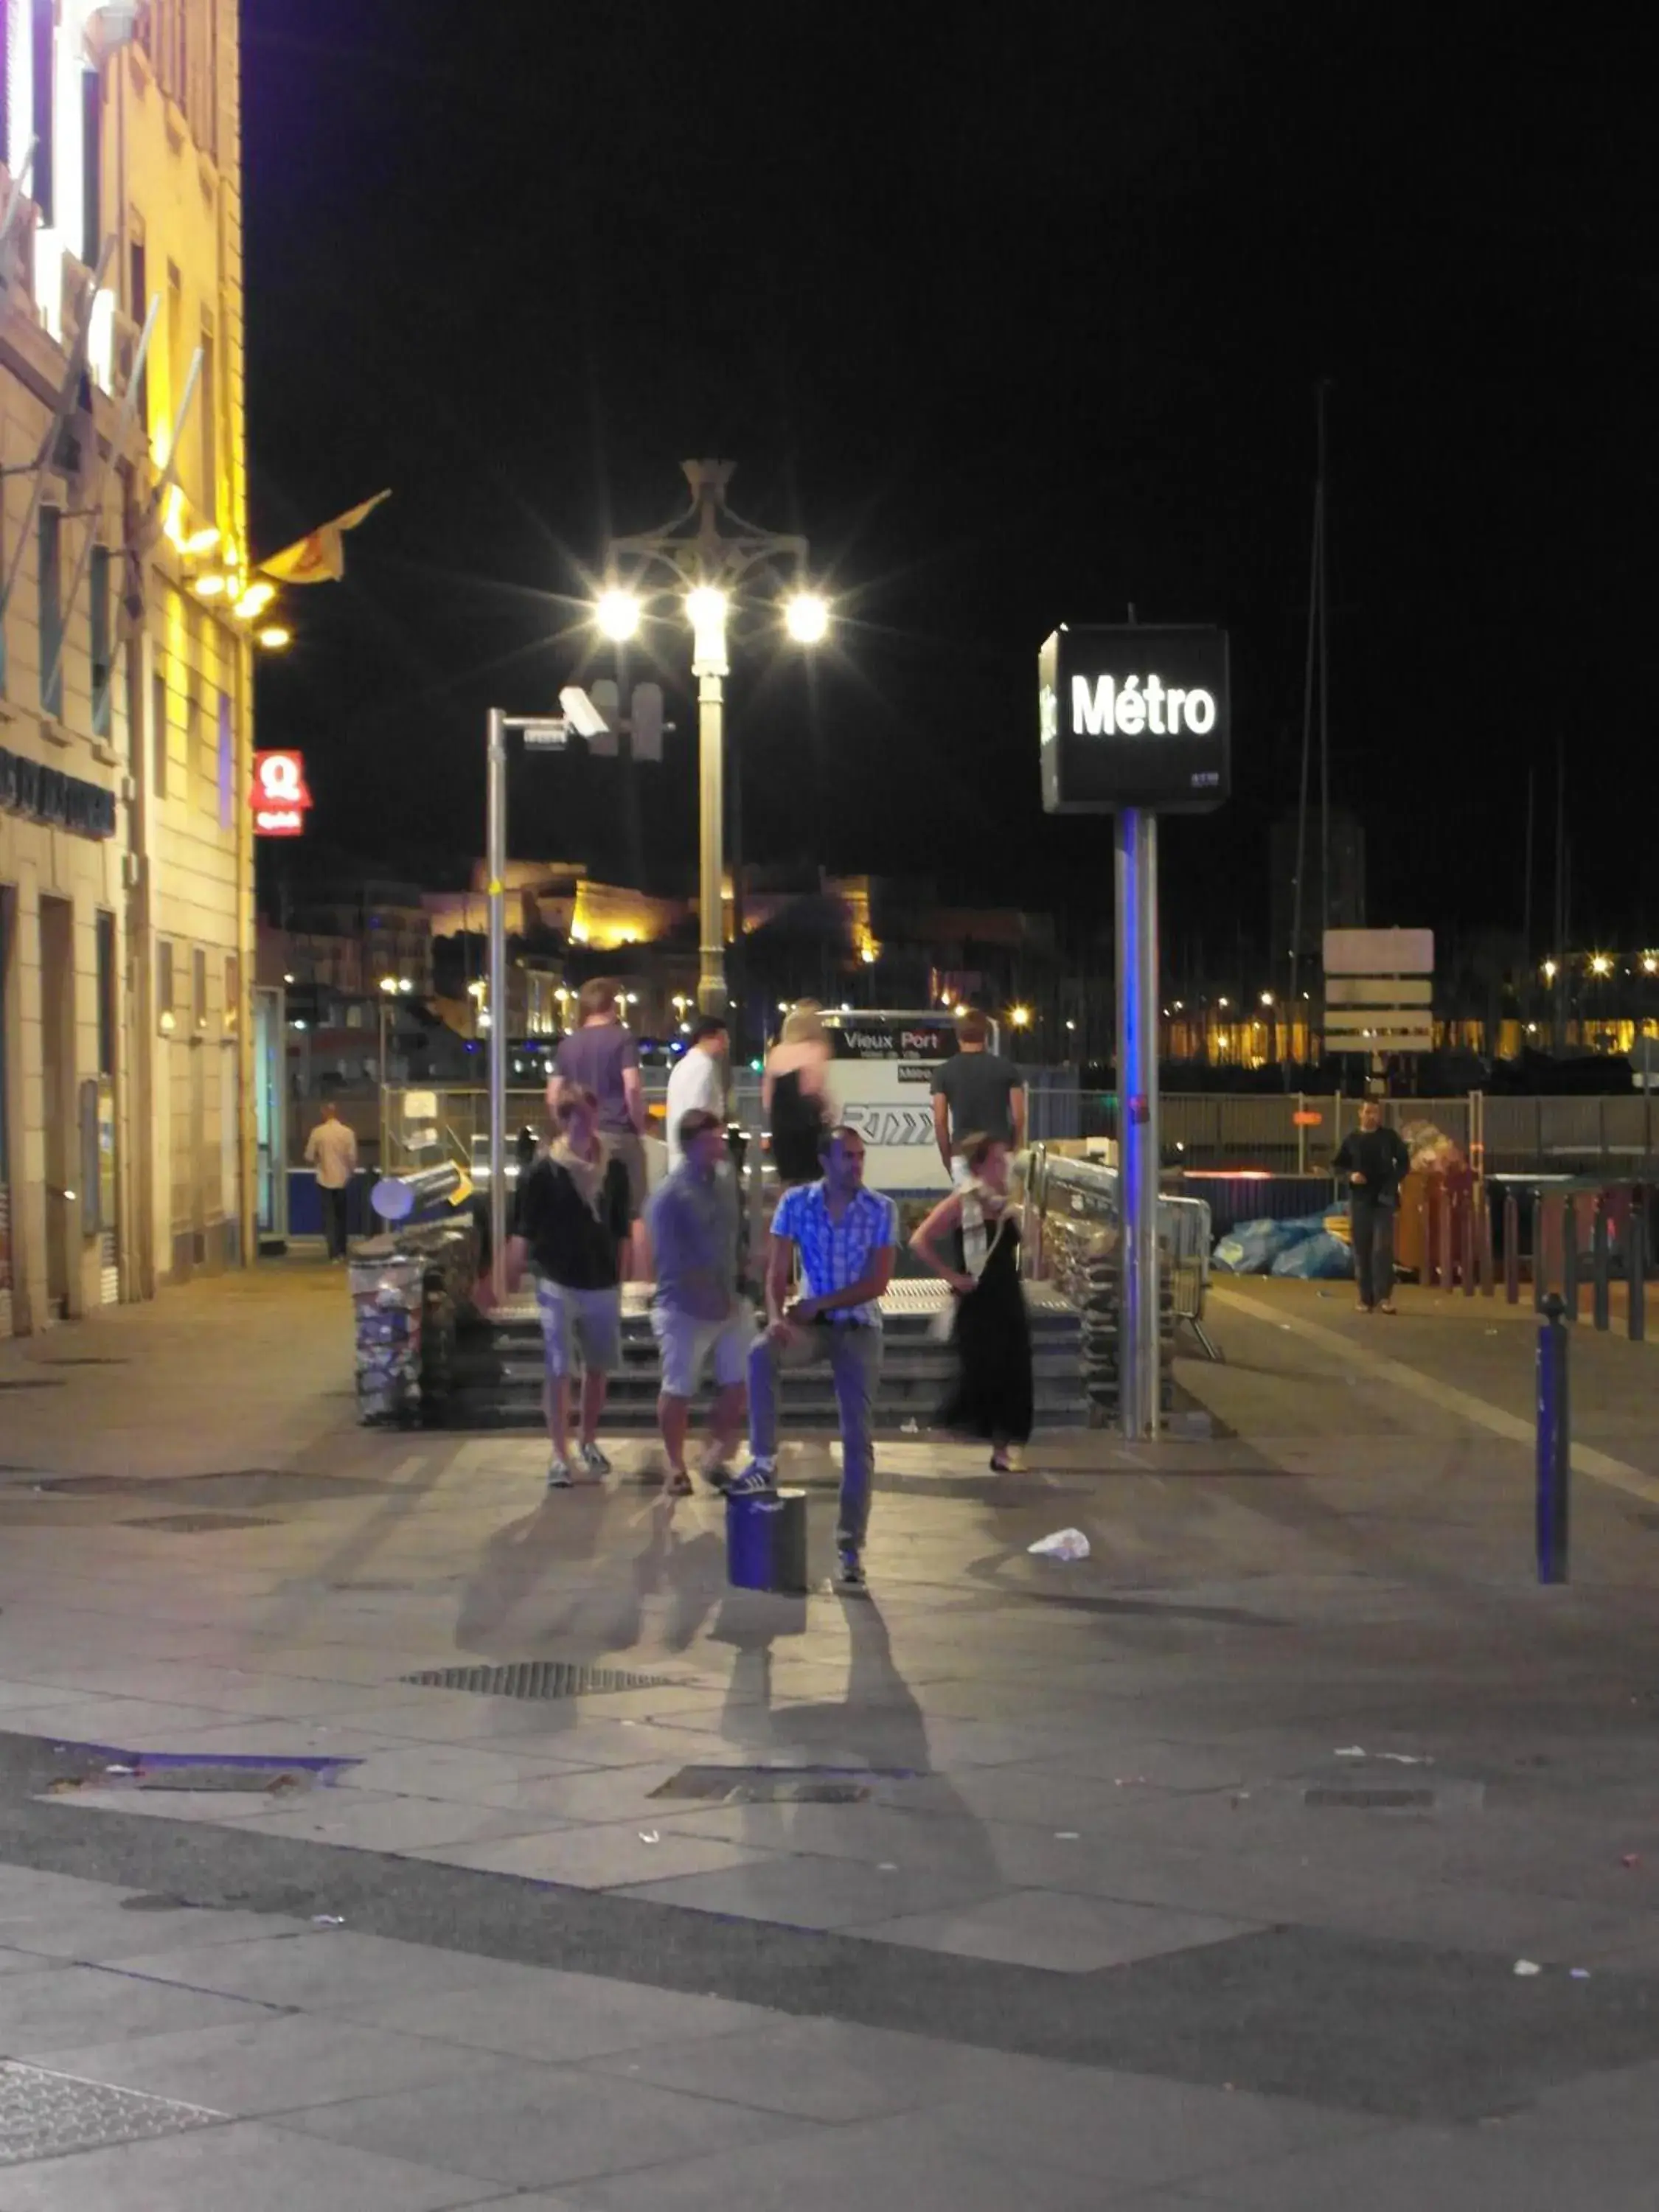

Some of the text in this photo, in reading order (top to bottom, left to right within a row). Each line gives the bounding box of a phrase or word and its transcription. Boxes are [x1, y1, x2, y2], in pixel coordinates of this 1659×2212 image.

[1072, 673, 1216, 735] Métro
[844, 1032, 939, 1048] Vieux Port
